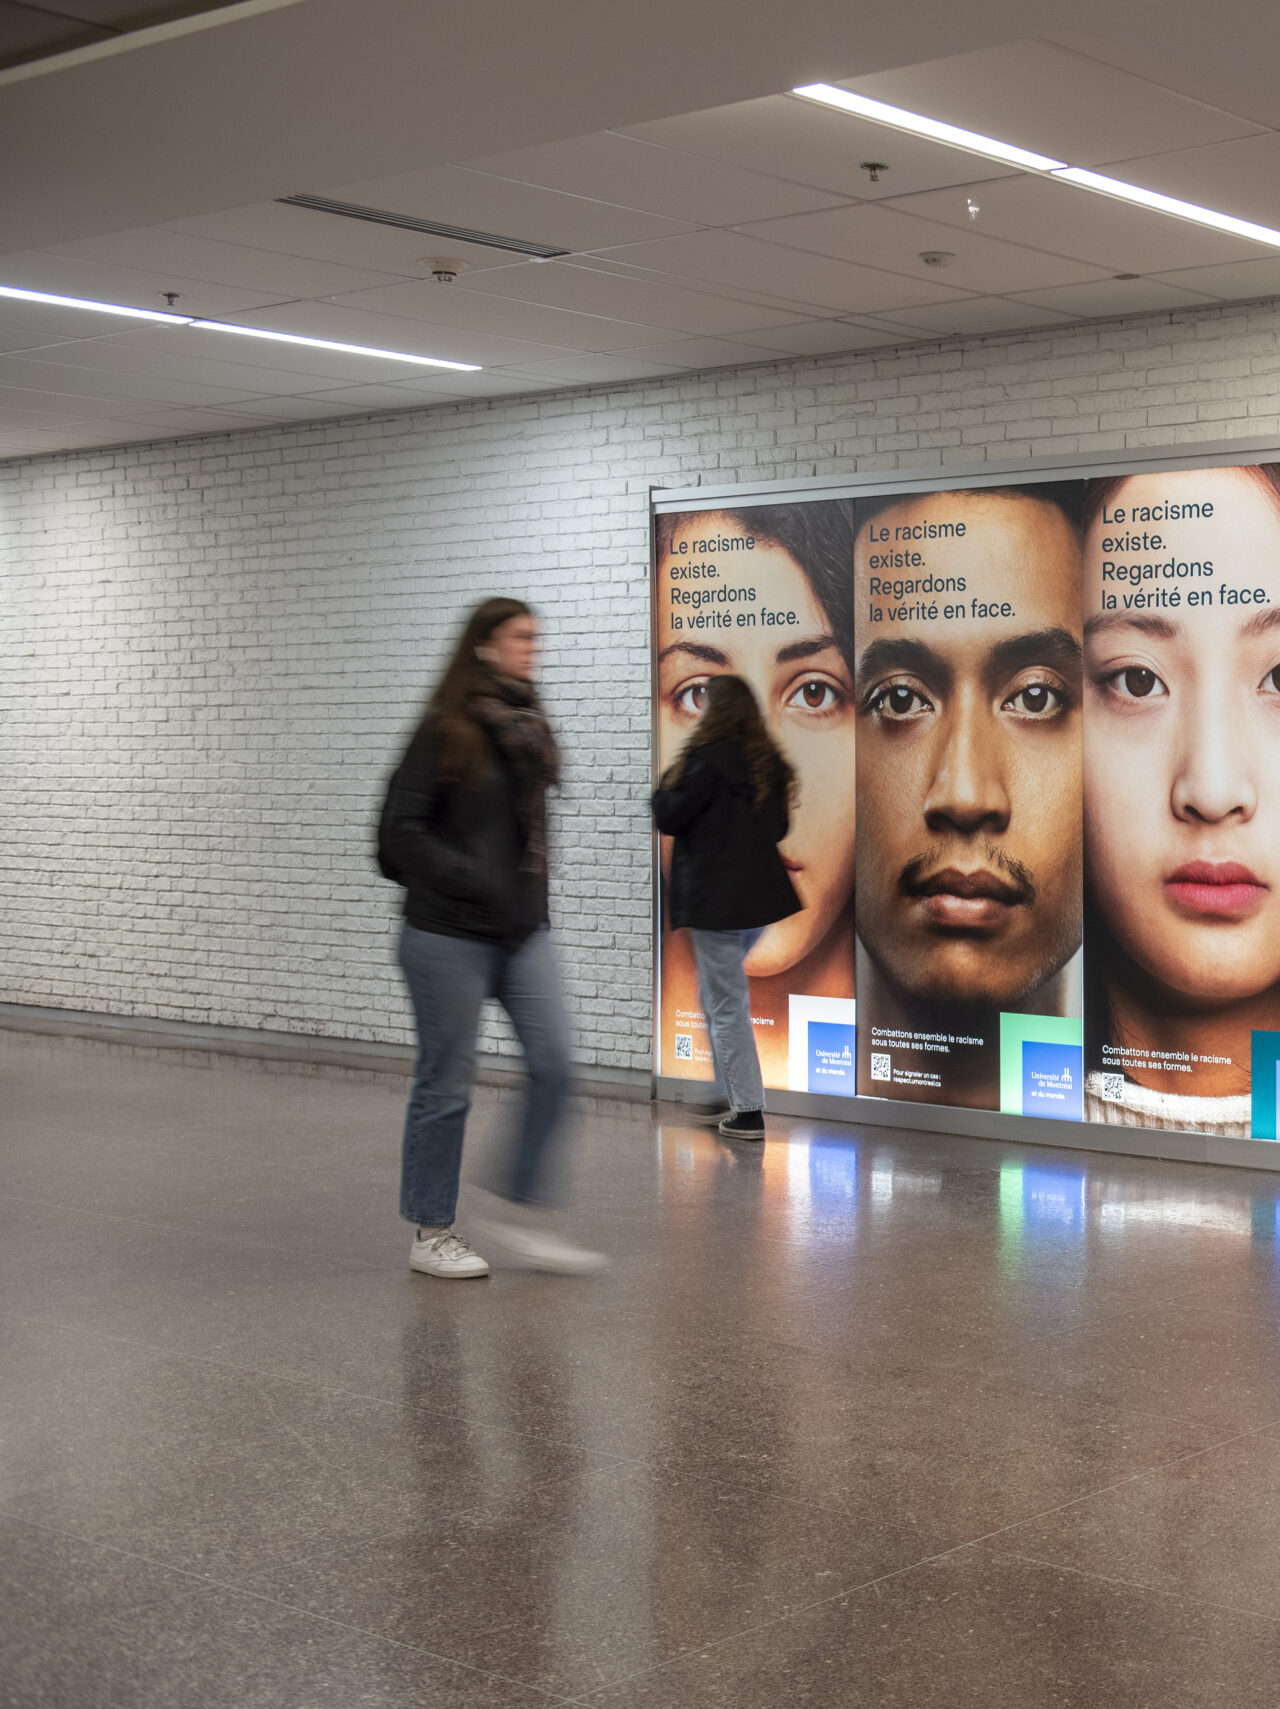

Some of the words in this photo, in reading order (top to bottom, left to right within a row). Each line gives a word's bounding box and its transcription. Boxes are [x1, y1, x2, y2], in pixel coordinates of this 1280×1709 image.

[1102, 504, 1126, 524] Le
[1132, 500, 1214, 522] racisme
[869, 525, 890, 542] Le
[895, 520, 966, 540] racisme
[670, 538, 688, 555] Le
[692, 534, 755, 553] racisme
[1102, 531, 1167, 553] existe.
[869, 549, 926, 569] existe.
[670, 562, 720, 580] existe.
[1102, 557, 1213, 586] Regardons
[671, 585, 756, 608] Regardons
[870, 574, 966, 600] Regardons
[1102, 589, 1117, 610] la
[1123, 586, 1181, 608] vérité
[1187, 590, 1212, 606] en
[1219, 584, 1271, 605] face.
[671, 612, 683, 630] la
[687, 610, 732, 629] vérité
[736, 612, 756, 627] en
[761, 608, 800, 626] face.
[869, 604, 883, 622] la
[887, 600, 938, 621] vérité
[944, 604, 966, 619] en
[971, 599, 1016, 618] face.
[675, 1009, 707, 1020] Combatto
[871, 1027, 913, 1039] Combattons
[914, 1031, 947, 1042] ensemble
[948, 1034, 955, 1043] le
[956, 1035, 984, 1046] racisme
[871, 1038, 887, 1046] sous
[888, 1039, 910, 1049] toutes
[911, 1042, 923, 1050] ses
[924, 1041, 950, 1053] formes.
[1102, 1045, 1149, 1058] Combattons
[1151, 1050, 1189, 1061] ensemble
[1191, 1053, 1198, 1062] le
[1200, 1054, 1232, 1065] racisme
[1102, 1057, 1121, 1065] sous
[1122, 1058, 1146, 1068] toutes
[1148, 1062, 1162, 1070] ses
[1163, 1061, 1193, 1073] formes.
[893, 1068, 904, 1076] Pour
[905, 1069, 923, 1078] signaler
[1031, 1072, 1059, 1081] Université
[1047, 1081, 1072, 1090] Montréal
